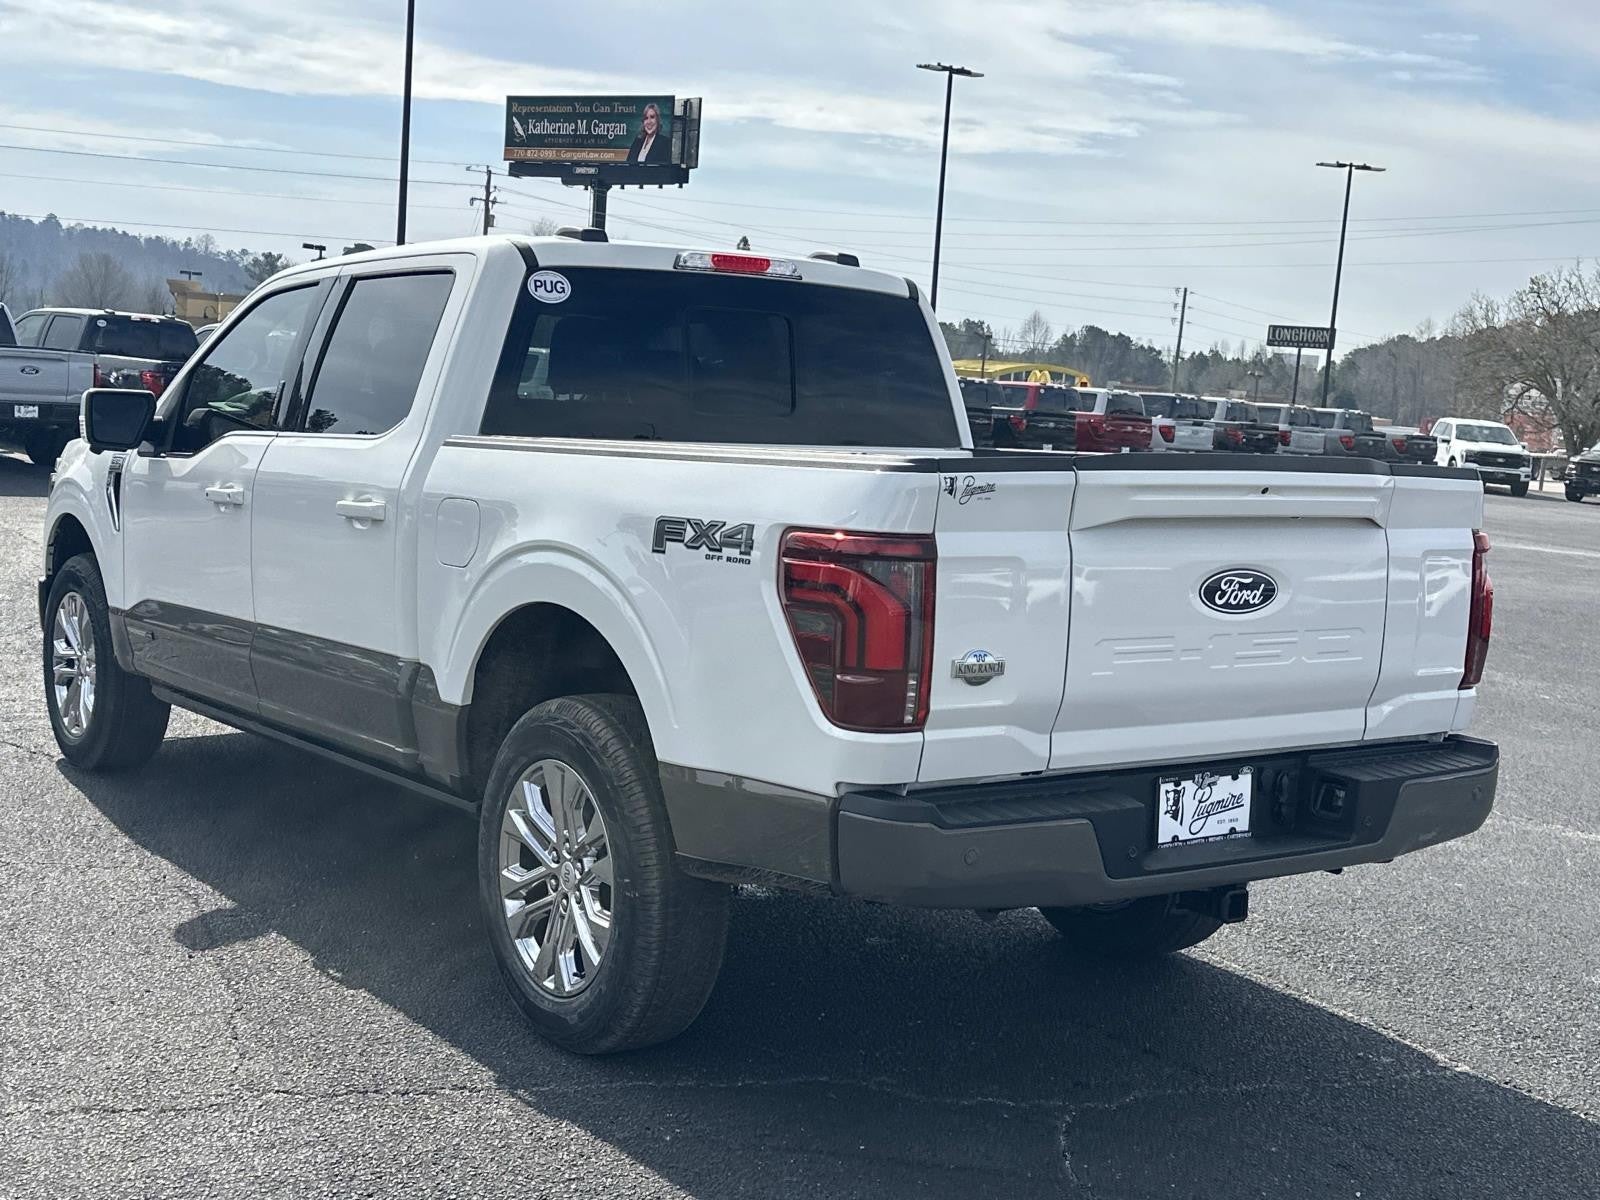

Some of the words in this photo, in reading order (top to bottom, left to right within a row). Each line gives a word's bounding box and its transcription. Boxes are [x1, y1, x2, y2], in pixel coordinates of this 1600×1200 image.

[512, 103, 573, 115] Representation
[574, 103, 590, 113] You
[593, 102, 611, 113] Can
[613, 103, 637, 113] Trust
[528, 119, 575, 135] Katherine
[577, 120, 589, 135] M.
[591, 120, 627, 139] Gargan
[533, 279, 566, 294] PUG
[1269, 326, 1330, 343] LONGHORN
[651, 515, 755, 556] FX4
[704, 553, 724, 561] OFF
[726, 556, 751, 565] ROAD
[1214, 576, 1265, 605] Ford
[958, 663, 977, 674] KING
[978, 661, 1003, 673] RANCH
[1189, 784, 1244, 835] Pugmire
